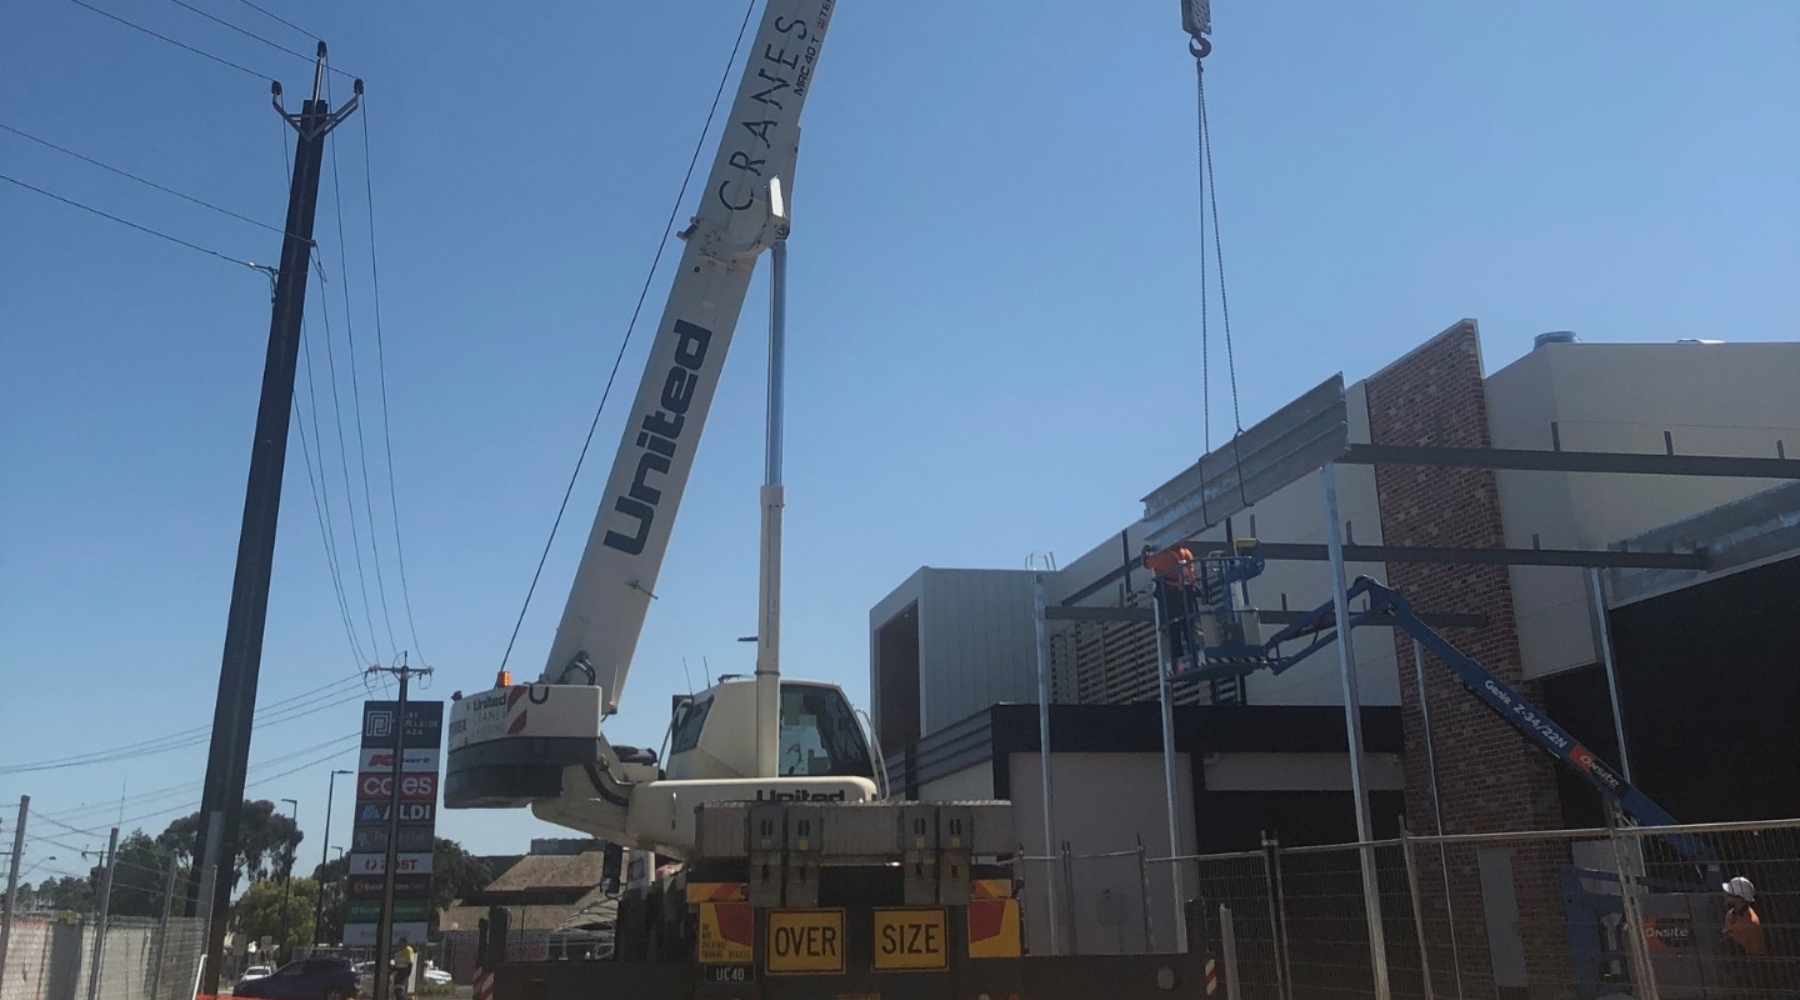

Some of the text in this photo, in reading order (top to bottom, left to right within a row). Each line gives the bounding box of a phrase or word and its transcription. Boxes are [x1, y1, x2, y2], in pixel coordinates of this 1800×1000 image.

[794, 66, 810, 96] MRC
[805, 46, 816, 64] 40
[719, 16, 808, 211] CRANES
[603, 318, 713, 556] United
[473, 692, 507, 711] United
[1485, 680, 1511, 705] Genie
[363, 776, 432, 796] coes
[756, 789, 845, 801] United
[381, 859, 418, 870] ST
[775, 924, 939, 957] OVER SIZE
[715, 967, 745, 981] UC40
